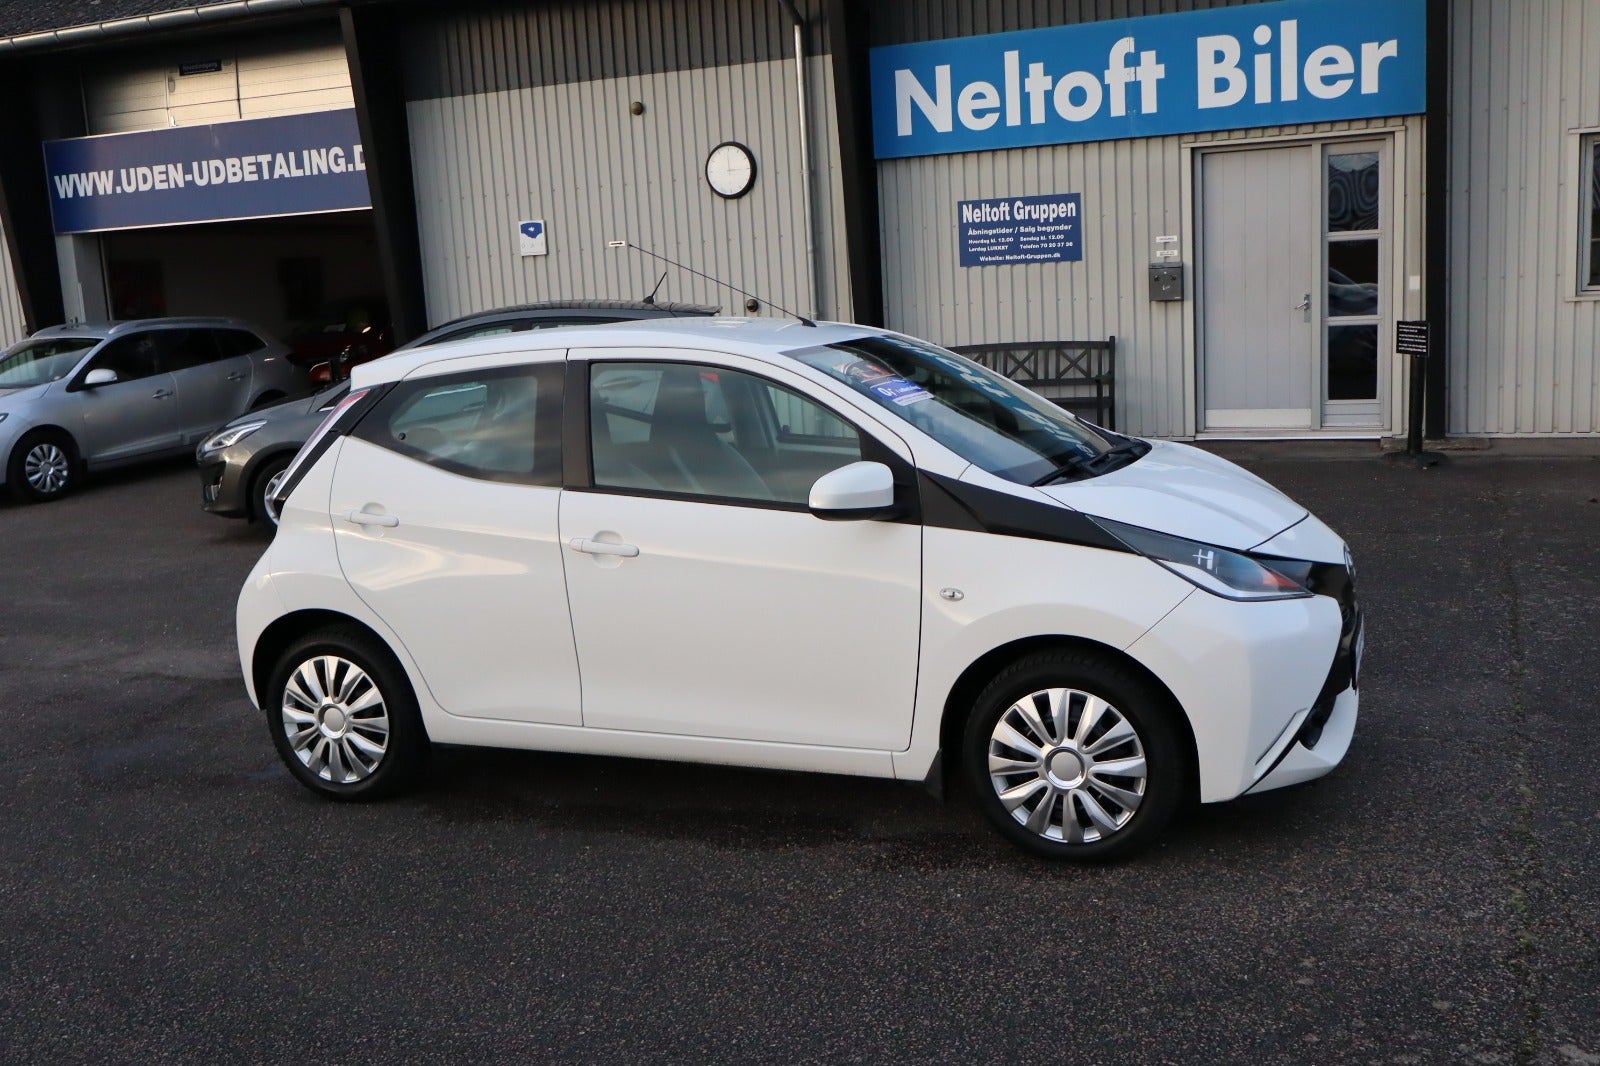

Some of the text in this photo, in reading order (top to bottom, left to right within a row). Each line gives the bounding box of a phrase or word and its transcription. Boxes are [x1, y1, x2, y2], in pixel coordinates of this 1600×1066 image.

[895, 19, 1398, 136] Neltoft Biler
[963, 201, 1076, 223] Neltoft Gruppen
[969, 227, 1013, 236] Åbningstider
[1020, 225, 1036, 233] Salg
[1037, 224, 1072, 232] begynder
